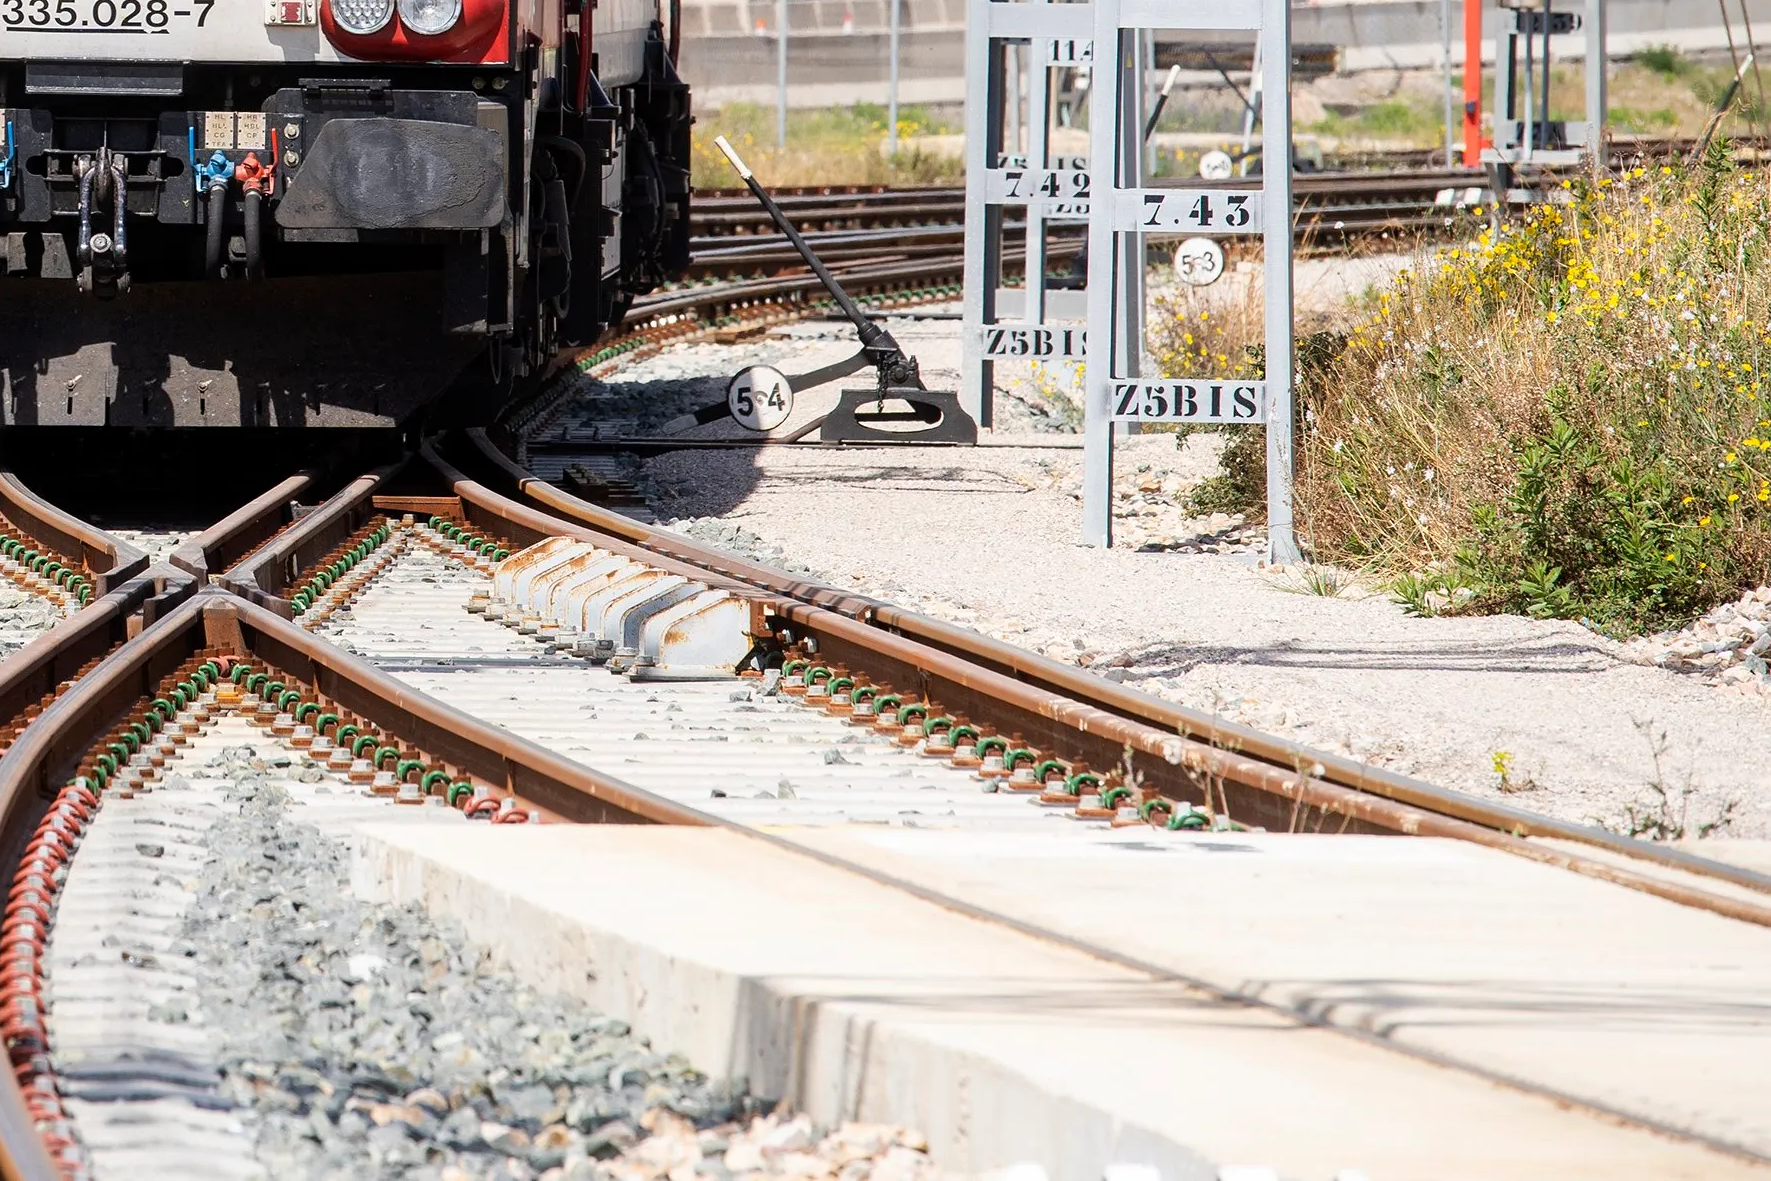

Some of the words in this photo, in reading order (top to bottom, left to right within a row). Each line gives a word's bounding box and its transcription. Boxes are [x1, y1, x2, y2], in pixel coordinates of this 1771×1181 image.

[1005, 172, 1091, 198] 7.42
[1143, 194, 1250, 227] 7.43
[986, 328, 1088, 356] Z5BI
[1115, 384, 1258, 418] Z5BIS
